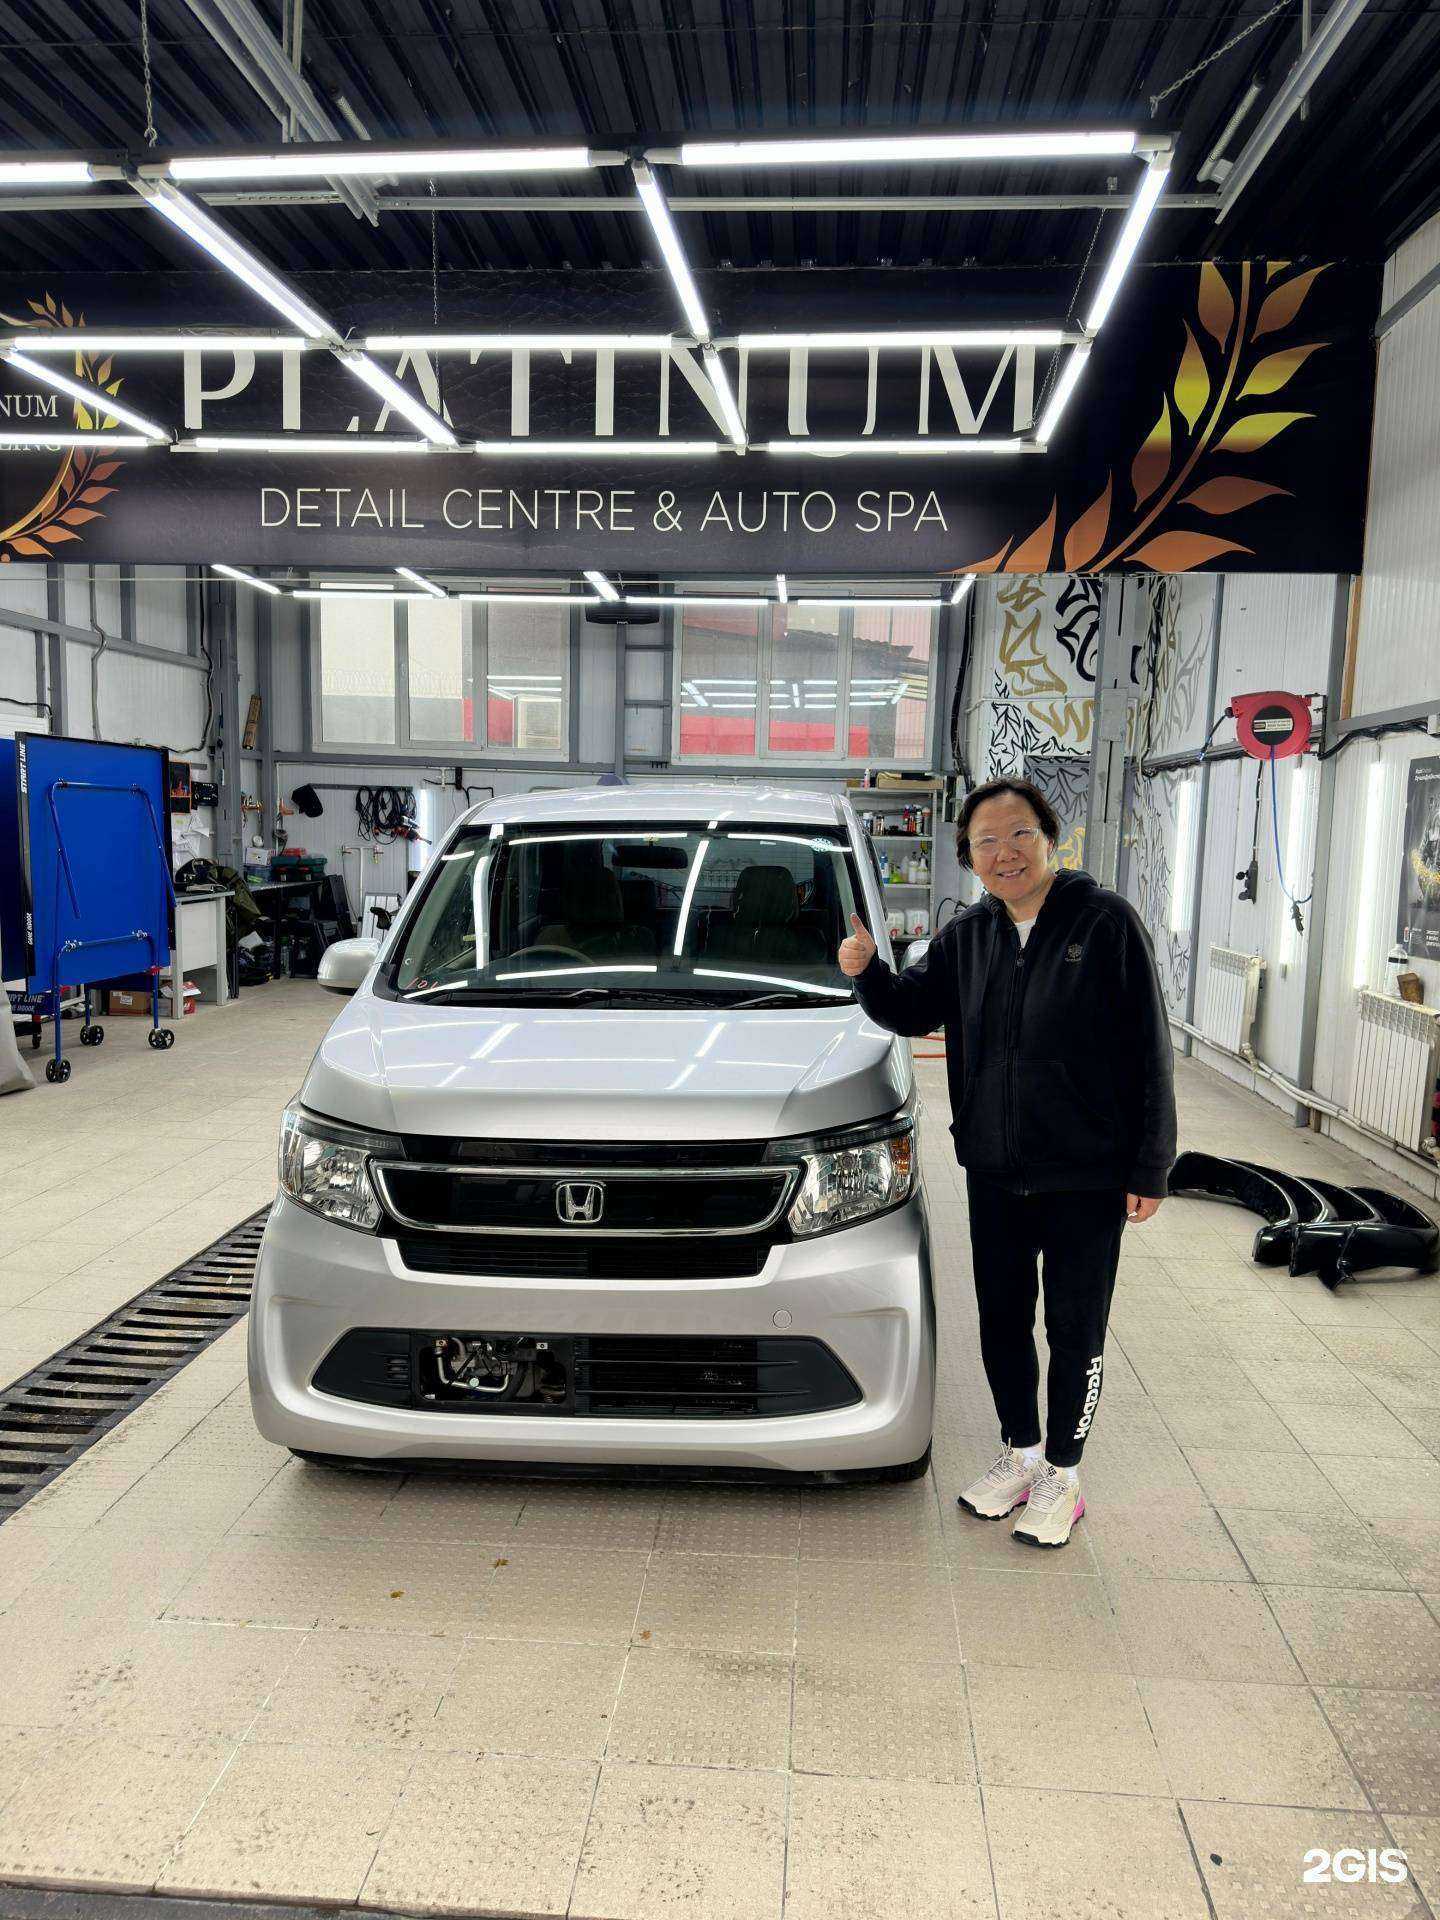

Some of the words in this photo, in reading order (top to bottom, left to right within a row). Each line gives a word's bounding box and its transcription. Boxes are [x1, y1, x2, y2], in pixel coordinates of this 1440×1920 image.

[261, 488, 424, 527] DETAIL
[443, 488, 636, 530] CENTRE
[653, 490, 682, 532] &
[700, 490, 836, 532] AUTO
[855, 491, 948, 532] SPA
[1074, 1355, 1102, 1439] Reebok
